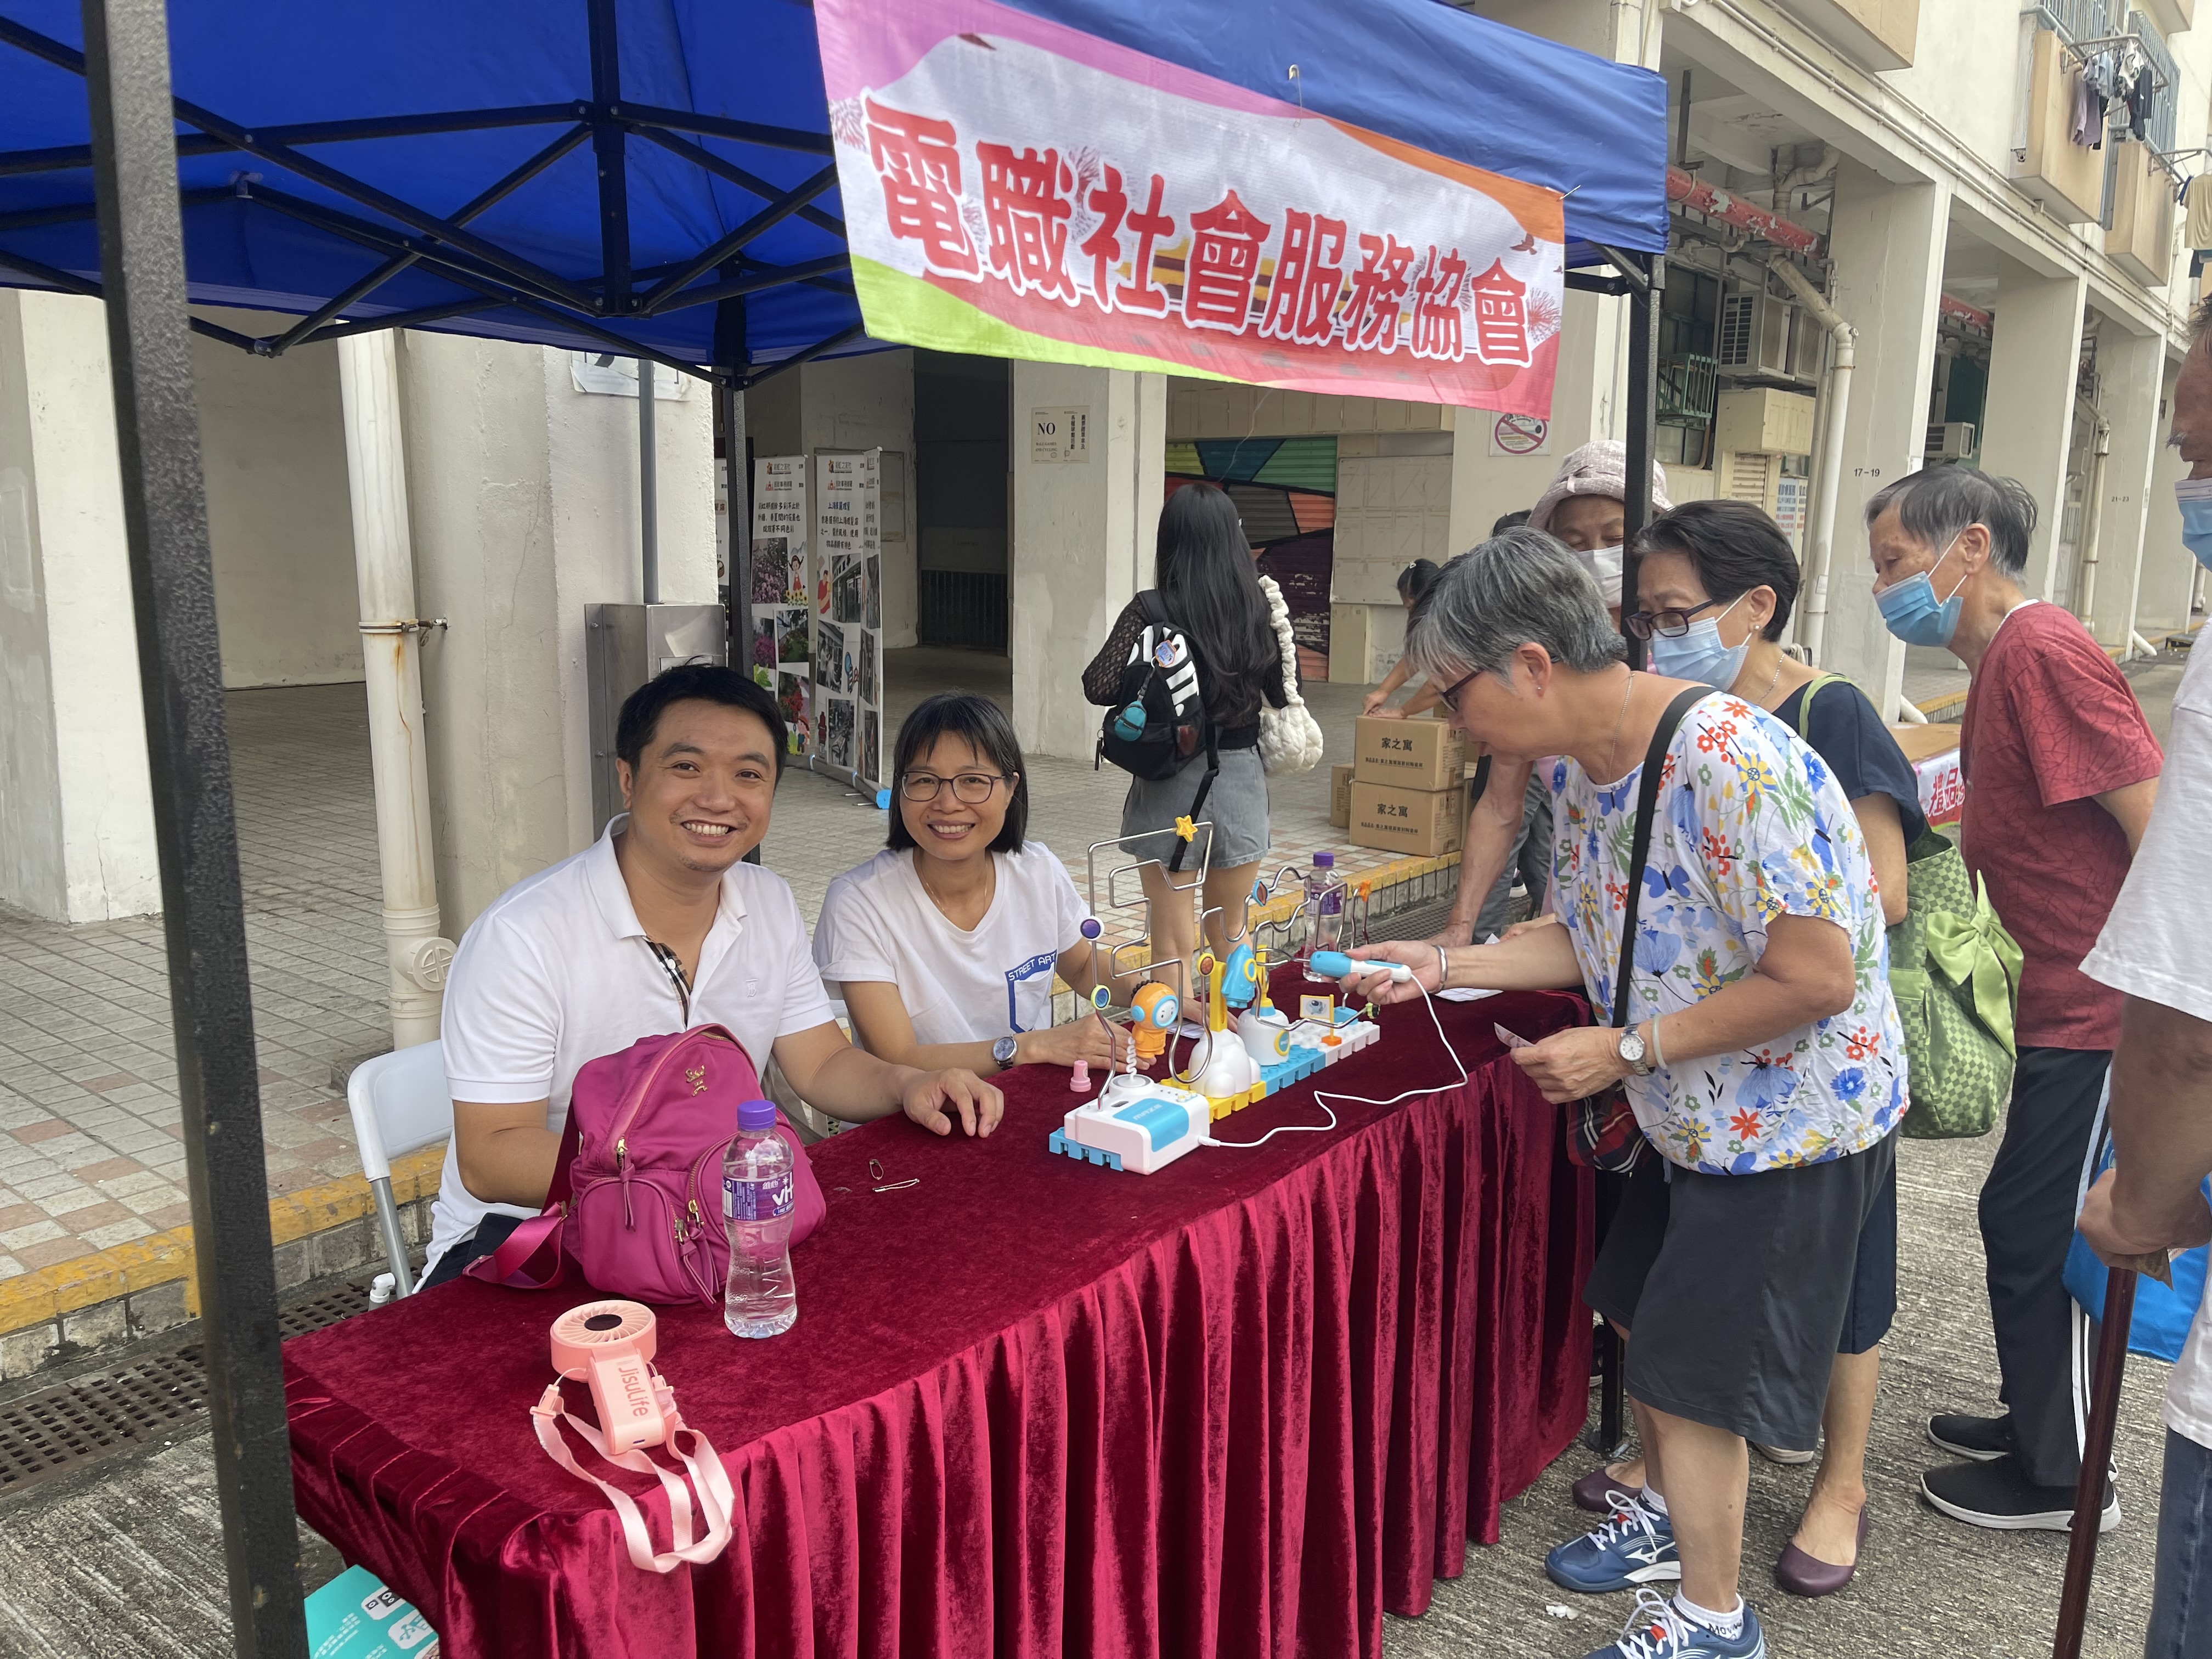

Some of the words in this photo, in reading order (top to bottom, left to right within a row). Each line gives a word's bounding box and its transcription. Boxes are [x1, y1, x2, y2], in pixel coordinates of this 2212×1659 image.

[864, 93, 1534, 366] 電職社會服務協會
[1037, 422, 1056, 435] NO
[1854, 468, 1880, 477] 17-19
[1381, 737, 1413, 752] 家之寓
[1377, 803, 1408, 817] 家之寓
[1008, 959, 1035, 981] STREET
[1038, 952, 1056, 966] ART
[618, 1368, 650, 1417] JisuLife
